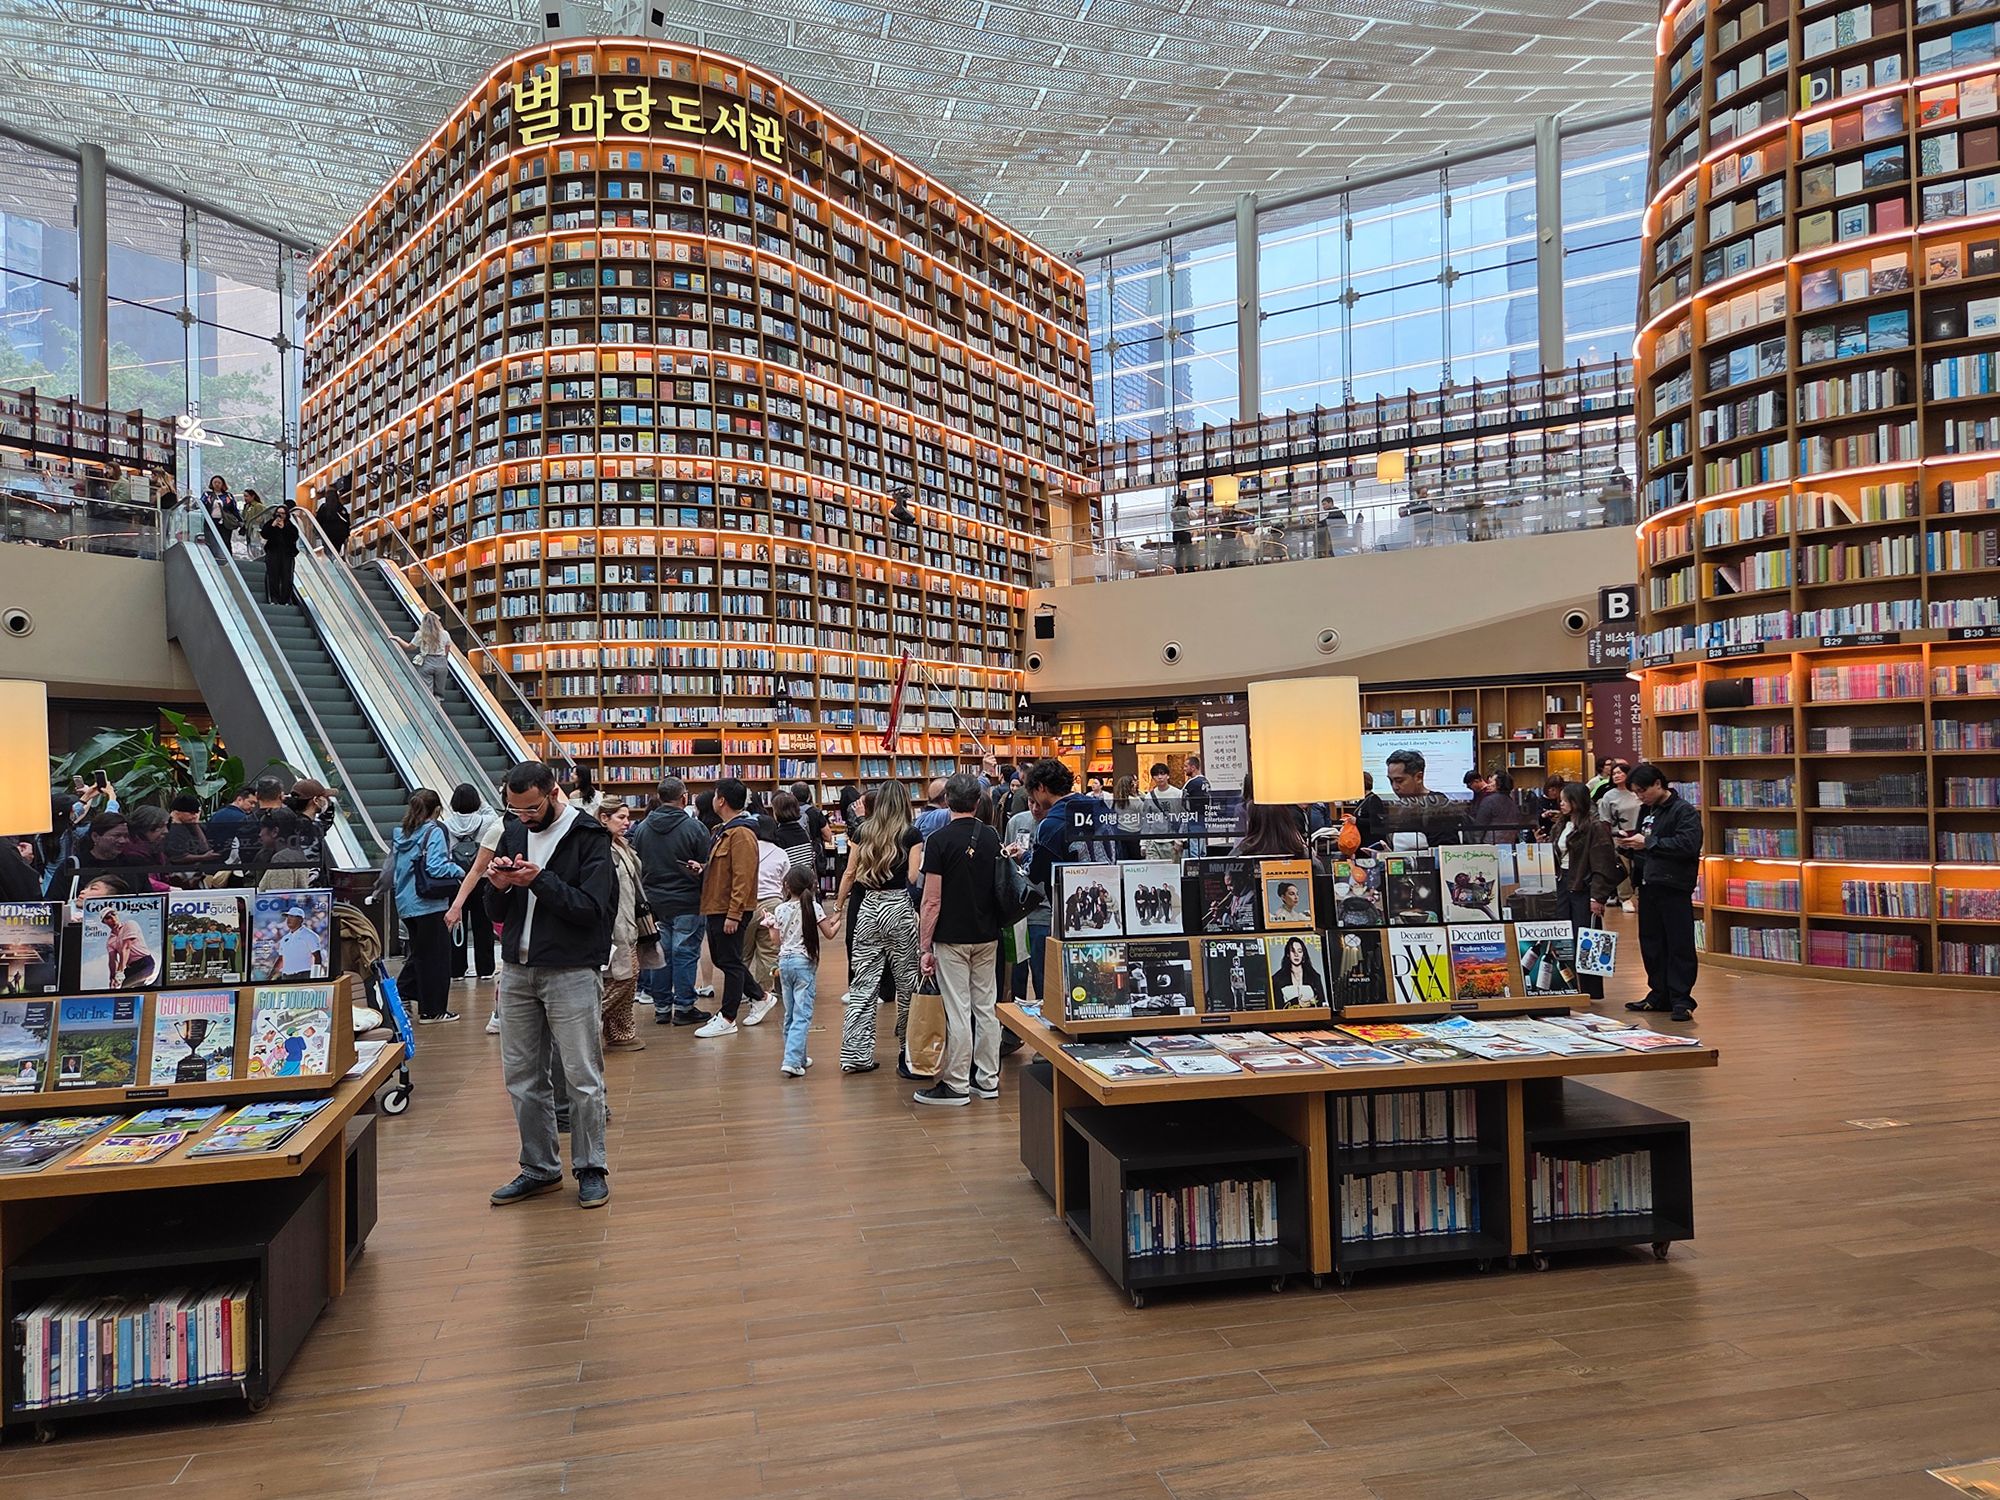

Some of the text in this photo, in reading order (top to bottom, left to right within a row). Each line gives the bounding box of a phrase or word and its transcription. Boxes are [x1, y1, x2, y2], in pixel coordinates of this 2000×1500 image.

[513, 65, 785, 164] 별마당 도서관
[1608, 592, 1630, 618] B
[1964, 629, 1984, 638] B30
[1823, 638, 1842, 646] B29
[1709, 649, 1722, 658] B28
[778, 676, 786, 692] A
[1018, 694, 1028, 708] A
[1074, 813, 1093, 827] D4
[1225, 863, 1244, 873] JAZZ
[171, 902, 237, 915] GOLF guide
[30, 917, 50, 925] LIST
[1452, 929, 1502, 941] Decanter
[1519, 926, 1569, 938] Decanter
[1070, 947, 1126, 963] EMPIRE
[2, 1011, 21, 1025] Inc
[66, 1006, 88, 1019] Golf
[90, 1007, 108, 1019] Inc
